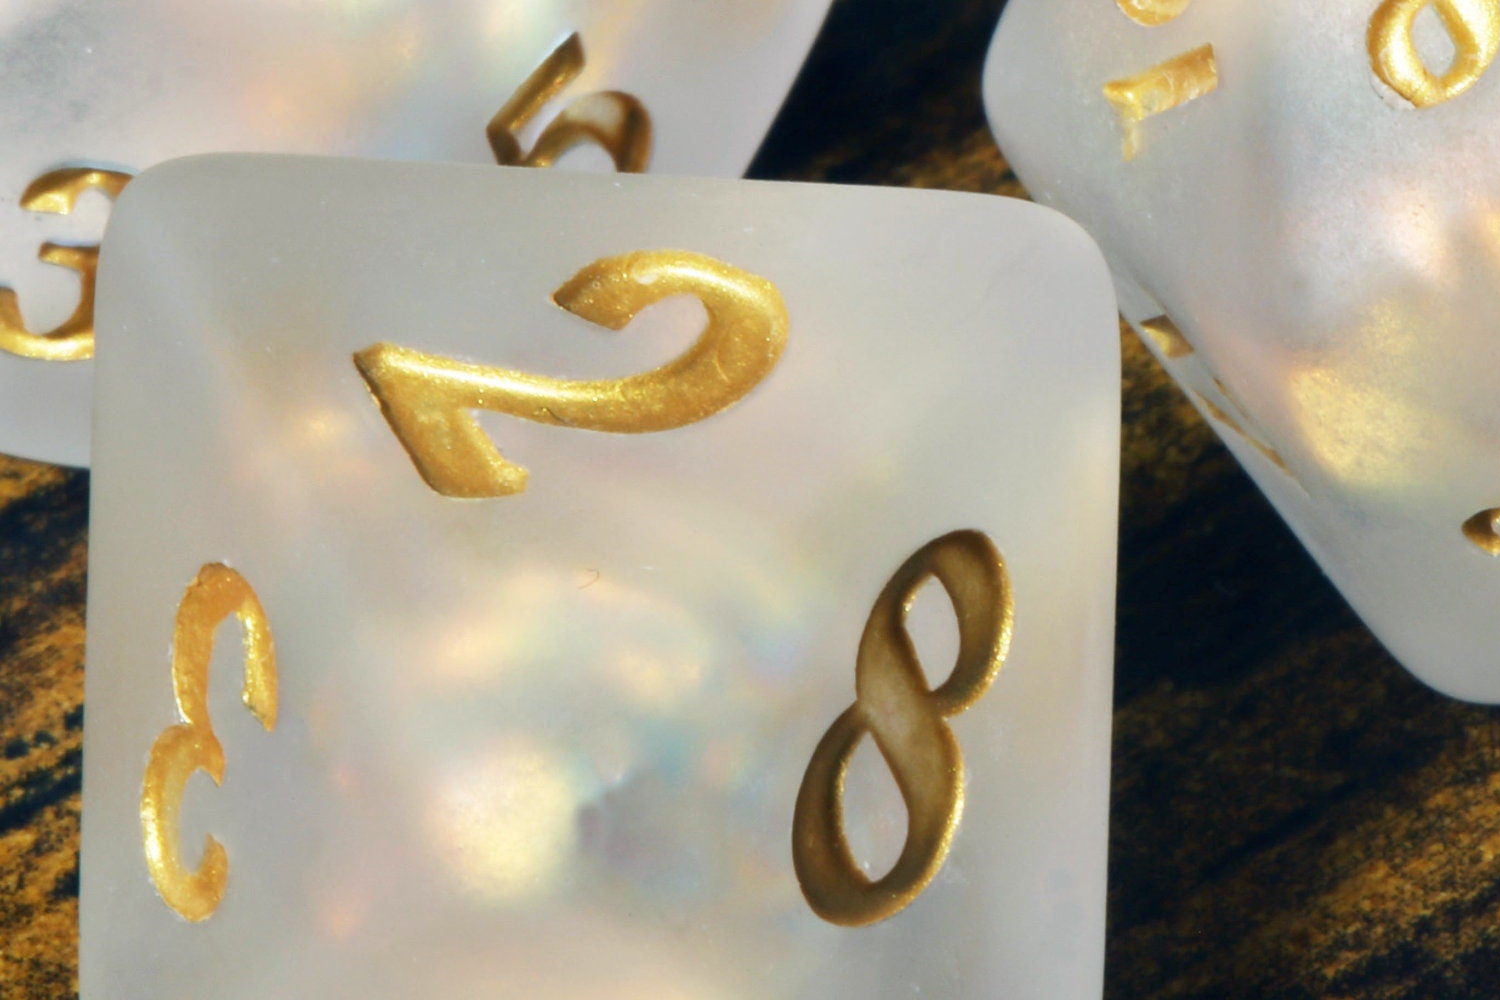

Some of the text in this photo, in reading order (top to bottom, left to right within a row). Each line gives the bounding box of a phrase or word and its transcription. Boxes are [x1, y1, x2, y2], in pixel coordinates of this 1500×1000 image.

[0, 166, 133, 361] 3
[352, 249, 789, 498] 2
[140, 561, 279, 924] 3
[792, 529, 1015, 928] 8
